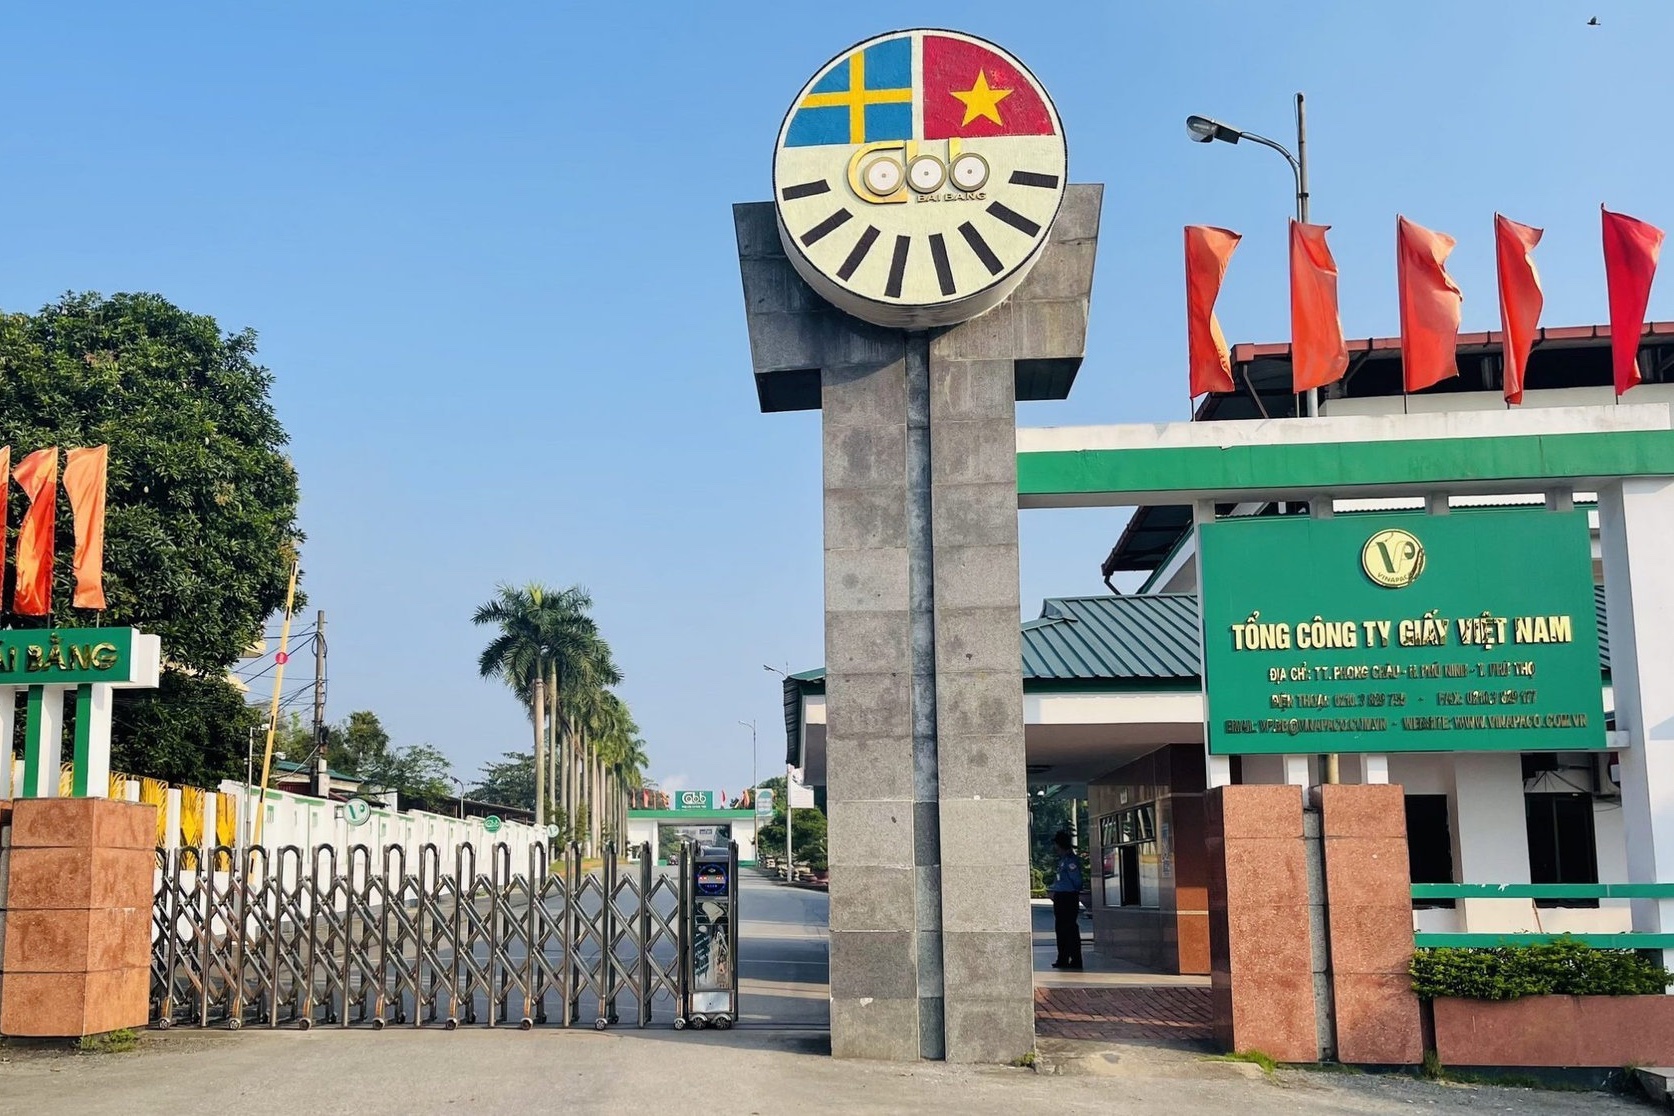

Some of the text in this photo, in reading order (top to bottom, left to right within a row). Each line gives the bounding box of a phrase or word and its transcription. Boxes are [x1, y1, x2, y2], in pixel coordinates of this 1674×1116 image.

[1377, 572, 1412, 583] VINAPAC
[1231, 608, 1572, 650] TỔNG CÔNG TY GIẤY VIỆT NAM
[1269, 667, 1287, 684] ĐỊA
[1290, 661, 1311, 681] CHỈ:
[1333, 665, 1369, 680] PHONG
[1513, 662, 1536, 679] THỌ
